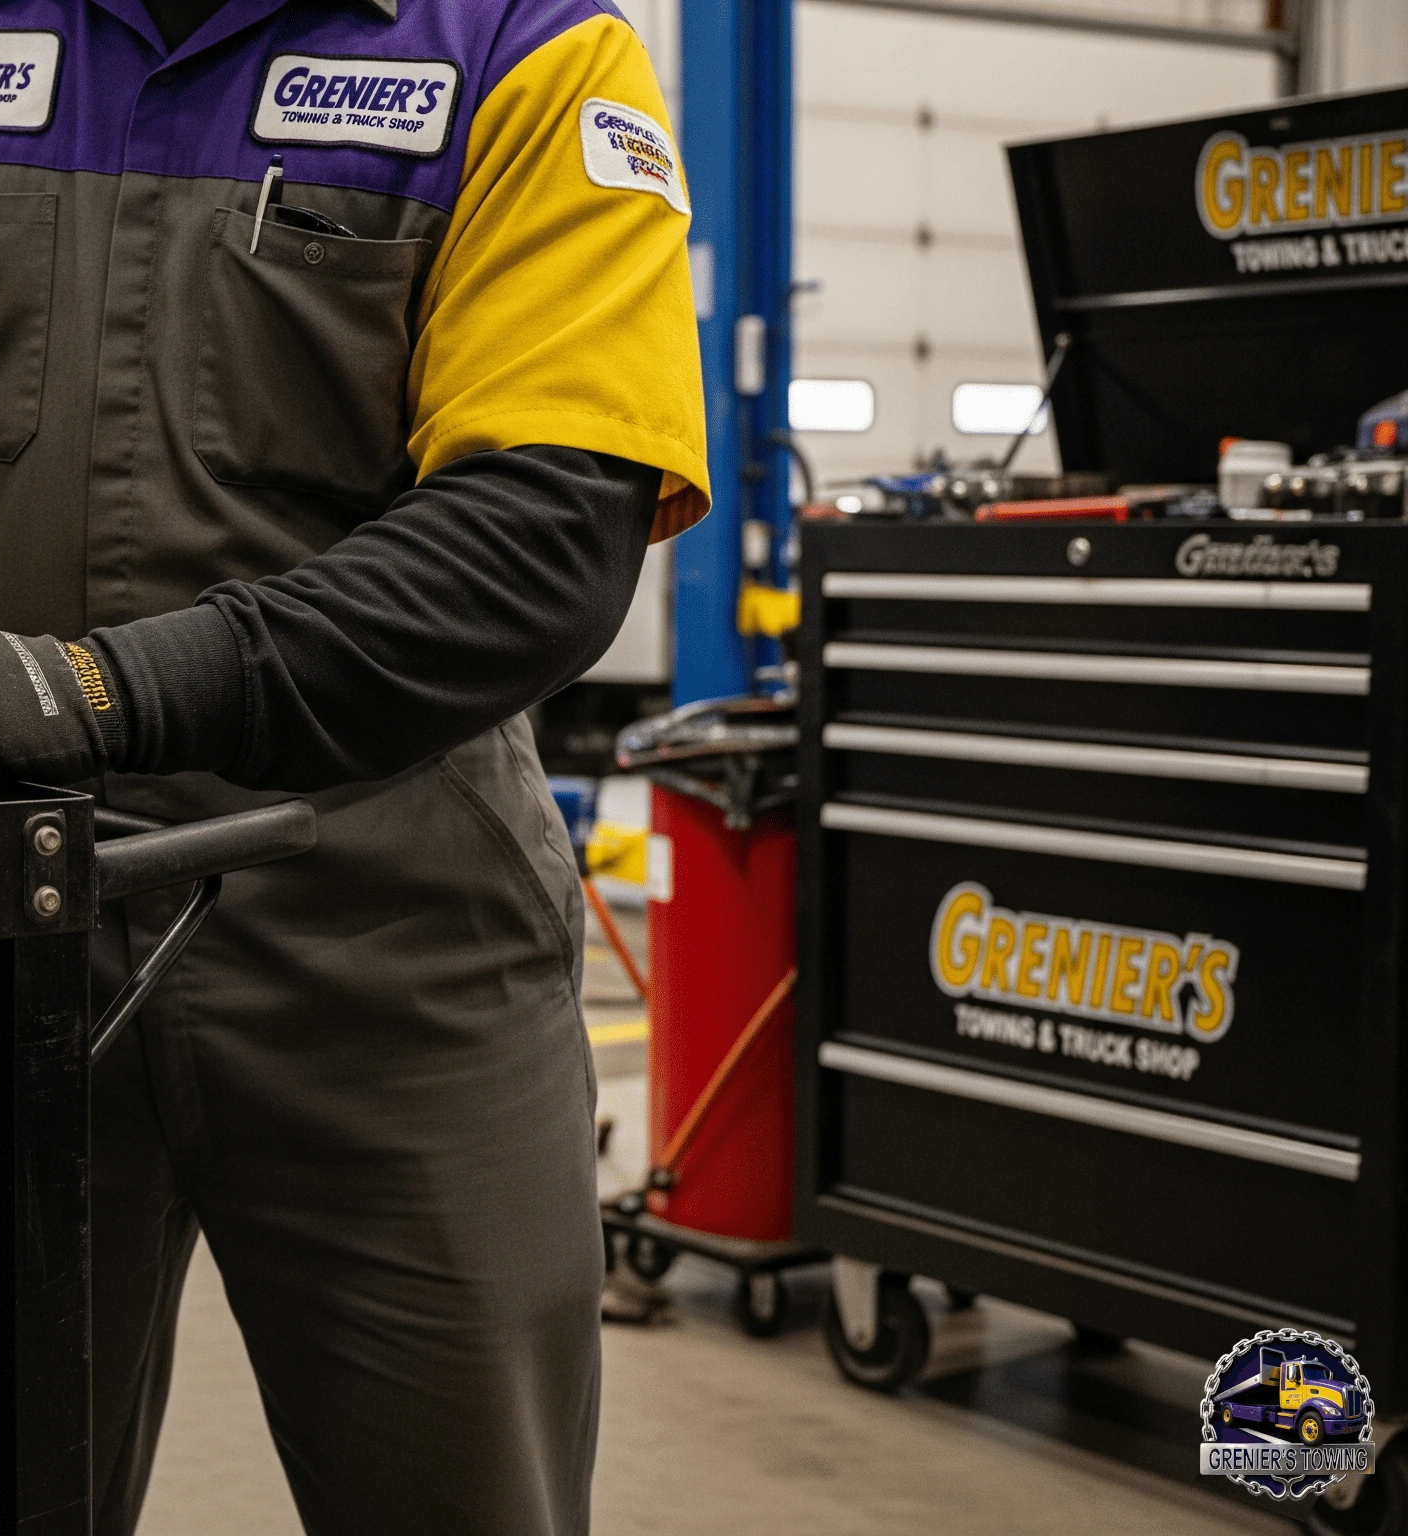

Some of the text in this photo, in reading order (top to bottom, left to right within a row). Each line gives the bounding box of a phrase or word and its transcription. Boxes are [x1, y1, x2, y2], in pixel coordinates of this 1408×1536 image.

[274, 66, 446, 115] GRENIER'S
[282, 110, 330, 125] TOWING
[346, 113, 388, 128] TRUCK
[388, 117, 424, 133] SHOP
[1320, 233, 1342, 267] &
[929, 880, 1240, 1043] GRENIER'S
[954, 1002, 1200, 1081] TOWING & TRUCK SHOP
